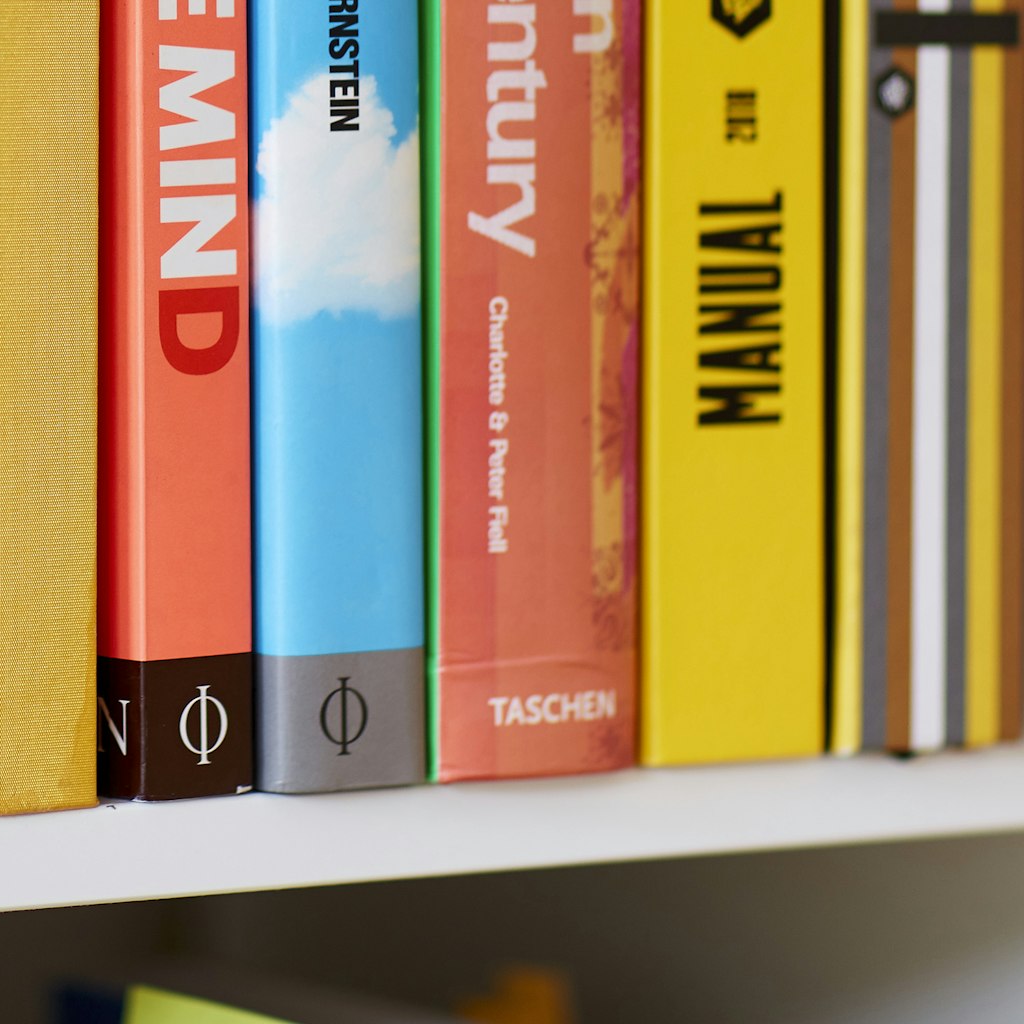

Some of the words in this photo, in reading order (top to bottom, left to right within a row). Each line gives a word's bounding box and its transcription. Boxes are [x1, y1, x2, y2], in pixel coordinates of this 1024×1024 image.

[158, 44, 241, 377] MIND
[697, 190, 783, 428] MANUAL
[487, 295, 509, 406] Charlotte
[487, 411, 509, 433] &
[487, 438, 509, 501] Peter
[487, 505, 509, 554] Fiell
[487, 690, 616, 727] TASCHEN
